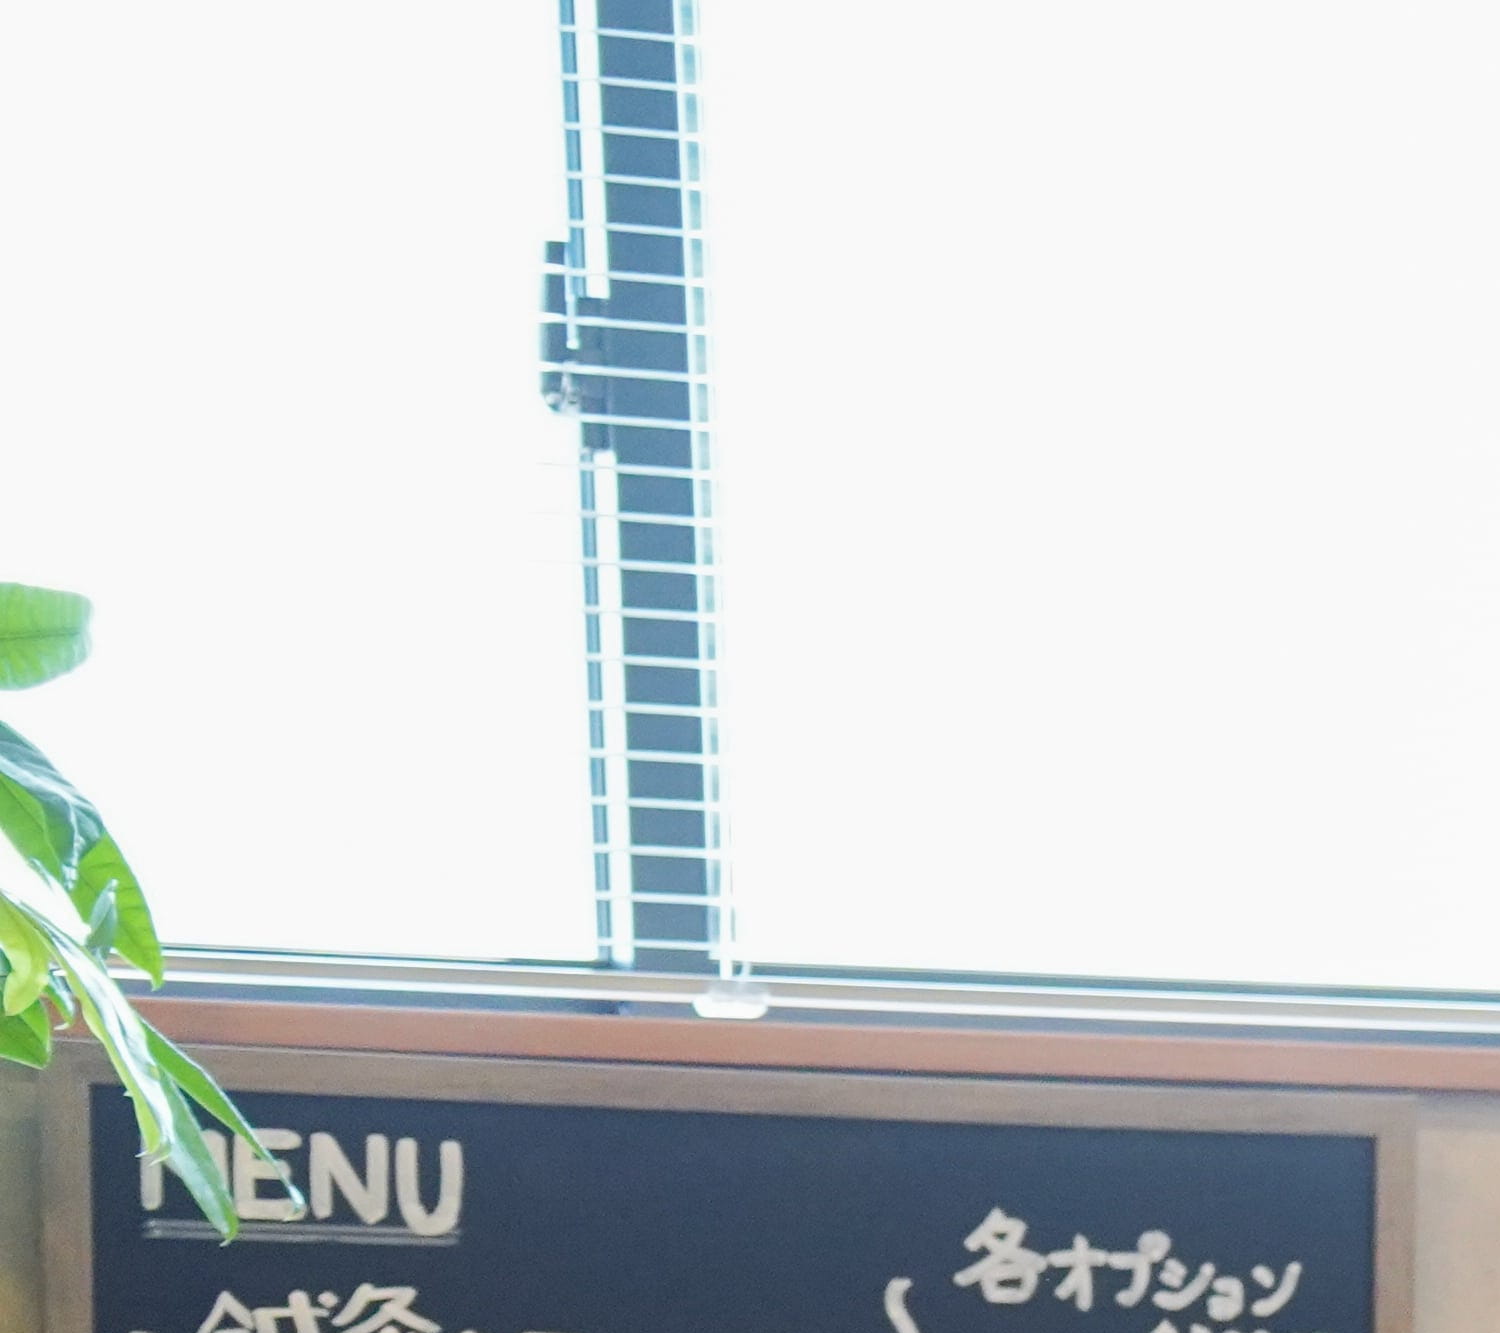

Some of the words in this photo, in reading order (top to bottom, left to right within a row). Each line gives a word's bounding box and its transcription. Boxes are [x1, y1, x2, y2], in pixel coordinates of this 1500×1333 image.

[953, 1207, 1302, 1322] 各オプション
